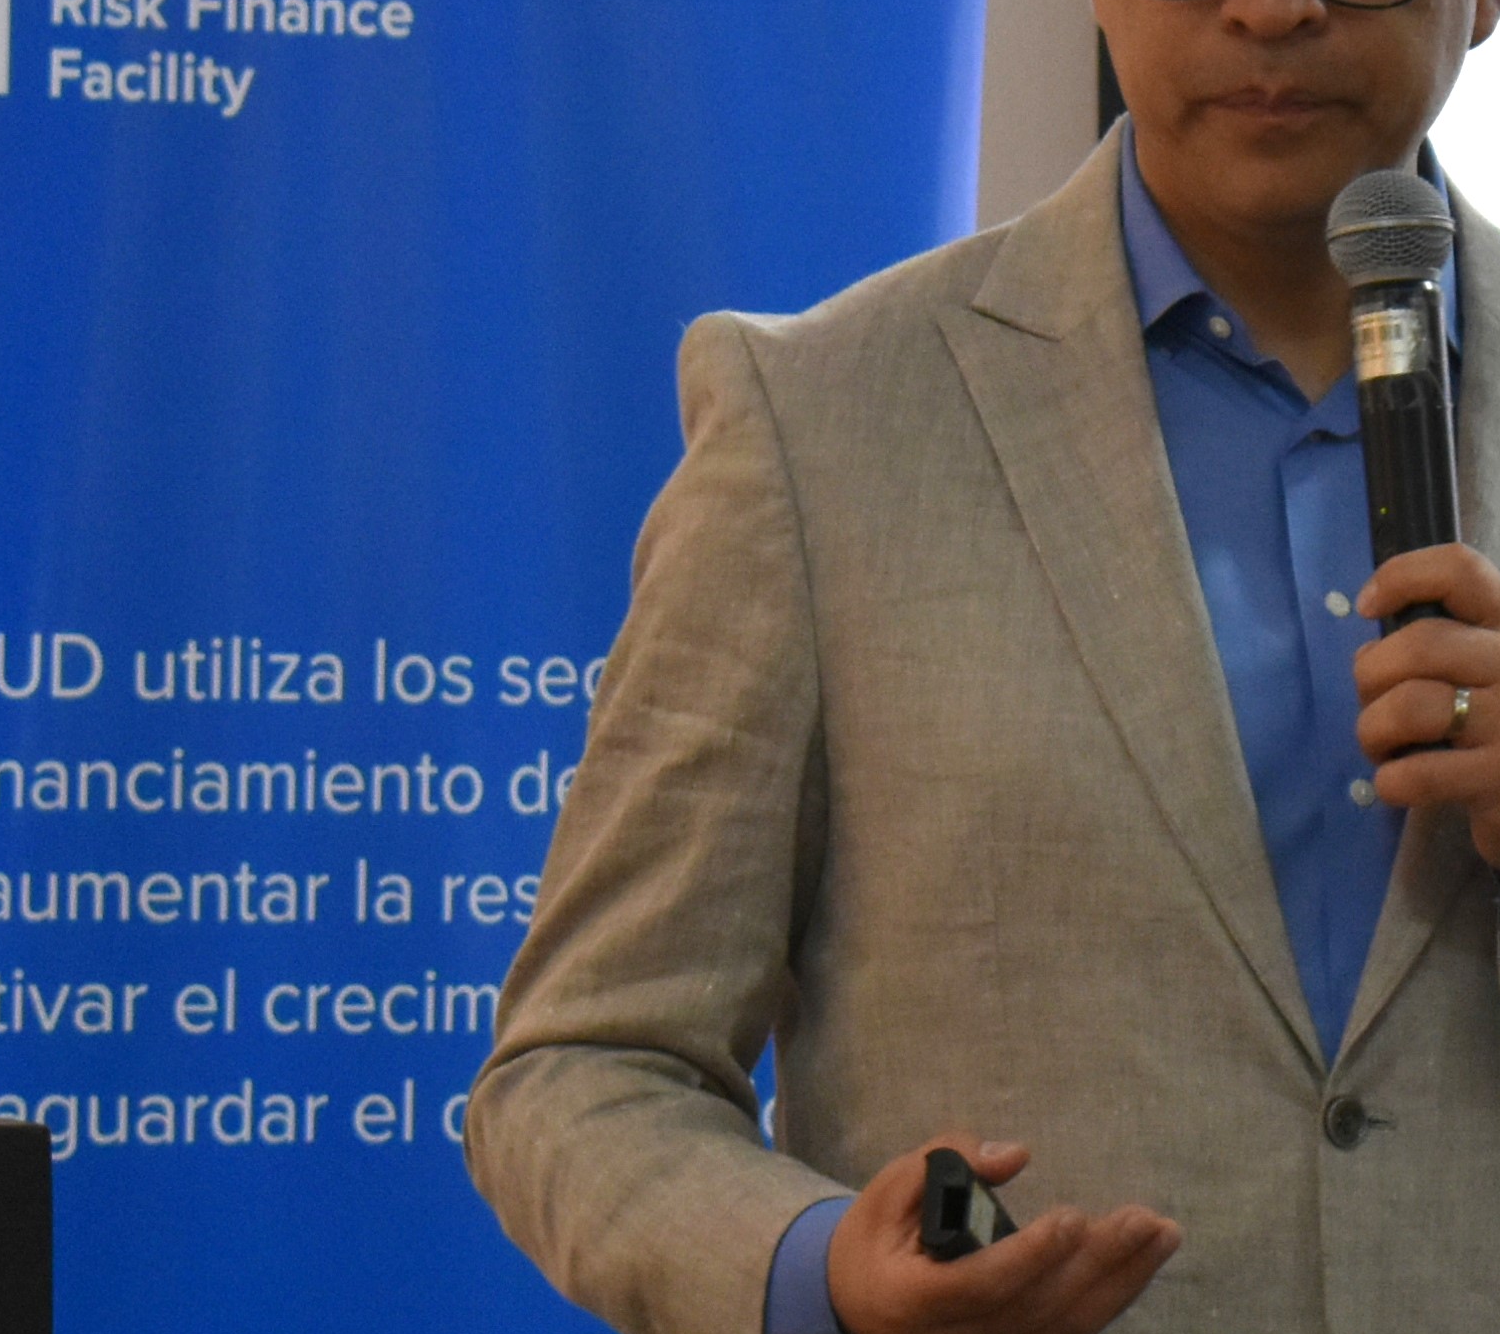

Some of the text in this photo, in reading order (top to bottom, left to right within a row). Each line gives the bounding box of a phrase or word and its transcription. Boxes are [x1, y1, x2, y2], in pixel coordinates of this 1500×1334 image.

[49, 47, 255, 118] Facility
[134, 635, 344, 704] utiliza
[374, 637, 474, 706] los
[356, 858, 413, 924] la
[174, 967, 236, 1035] el
[352, 1077, 415, 1145] el
